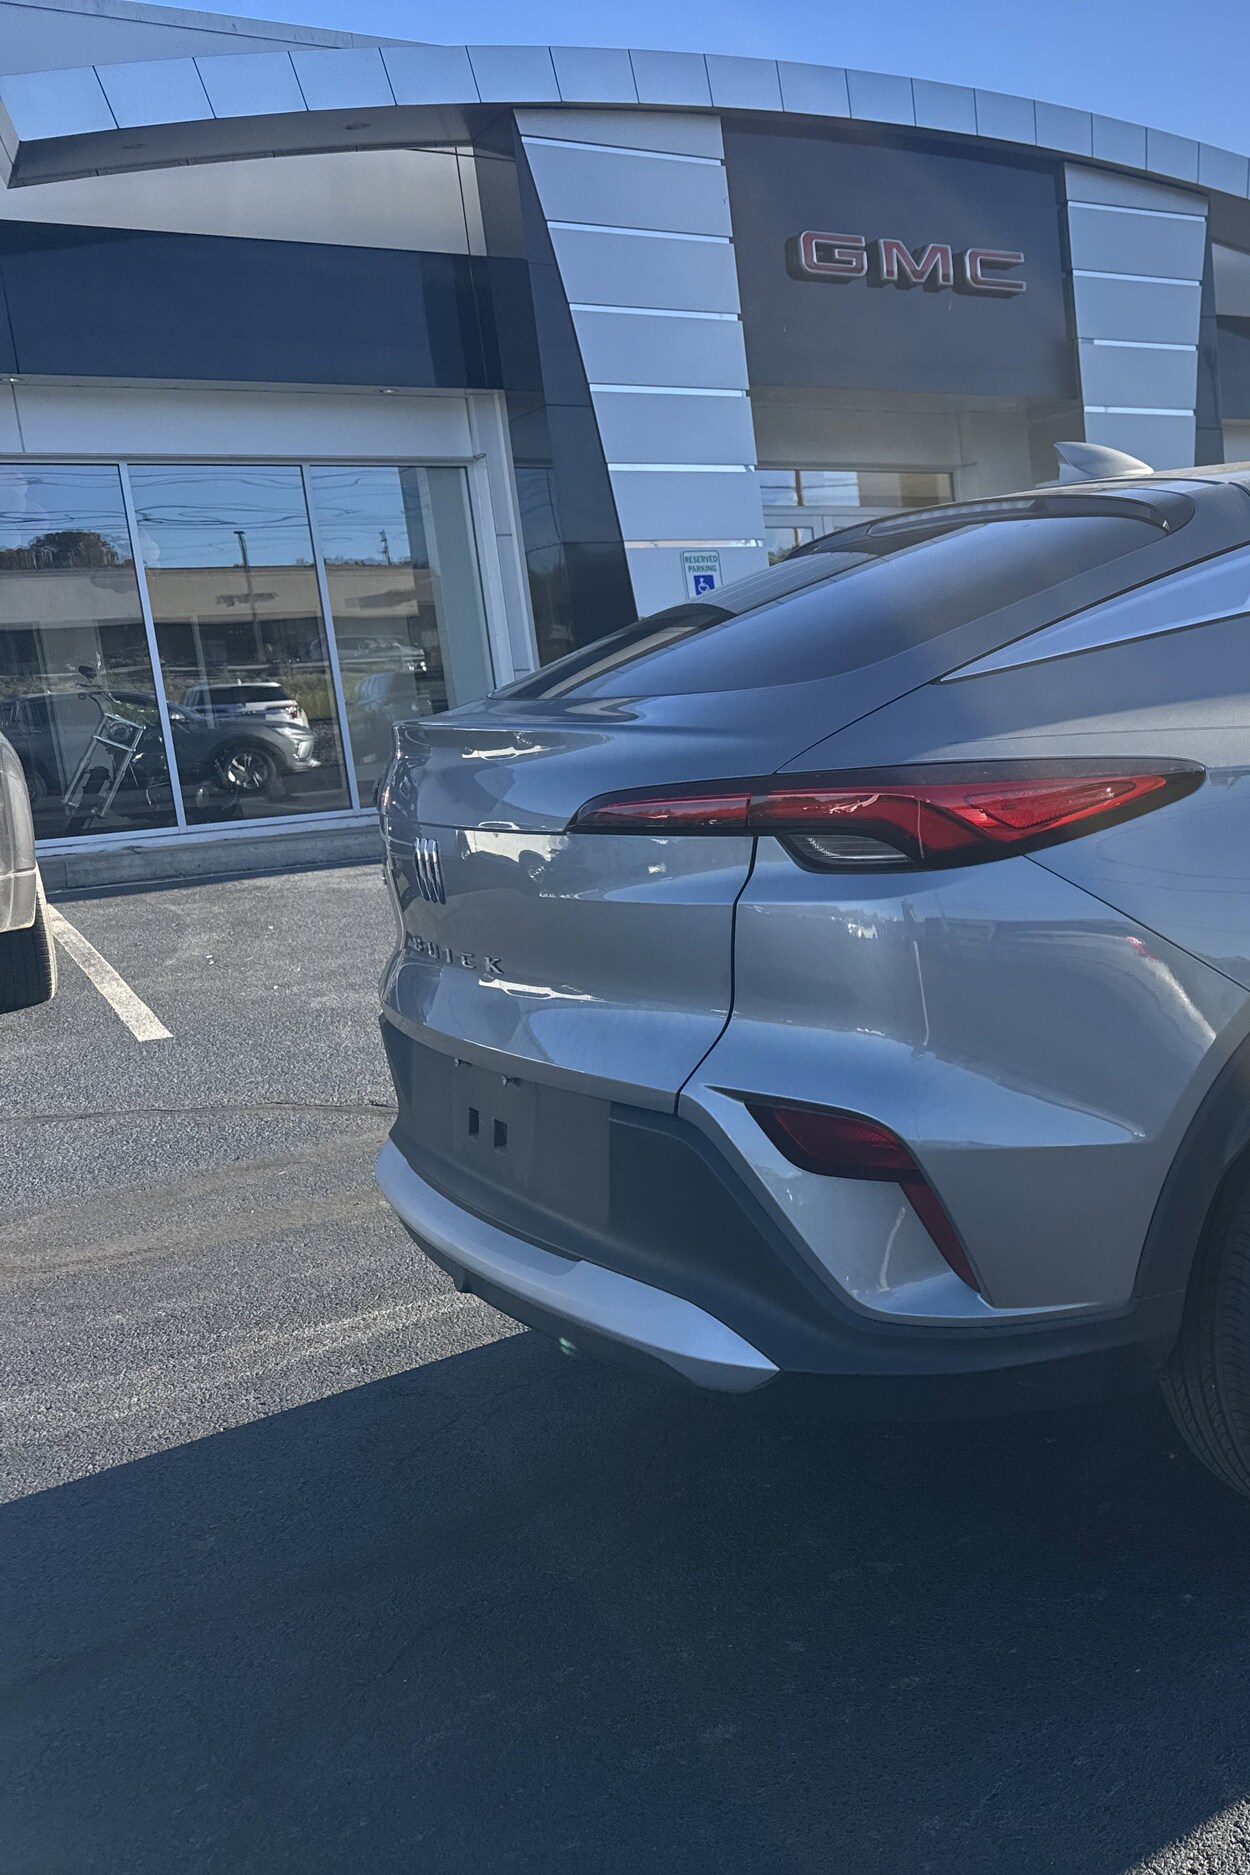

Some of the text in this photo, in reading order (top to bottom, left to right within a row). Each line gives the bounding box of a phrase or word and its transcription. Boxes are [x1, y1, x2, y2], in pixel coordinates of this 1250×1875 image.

[799, 230, 1027, 292] GMC
[684, 555, 718, 563] RESERVED
[688, 564, 718, 572] PARKING
[411, 935, 505, 975] BUICK
